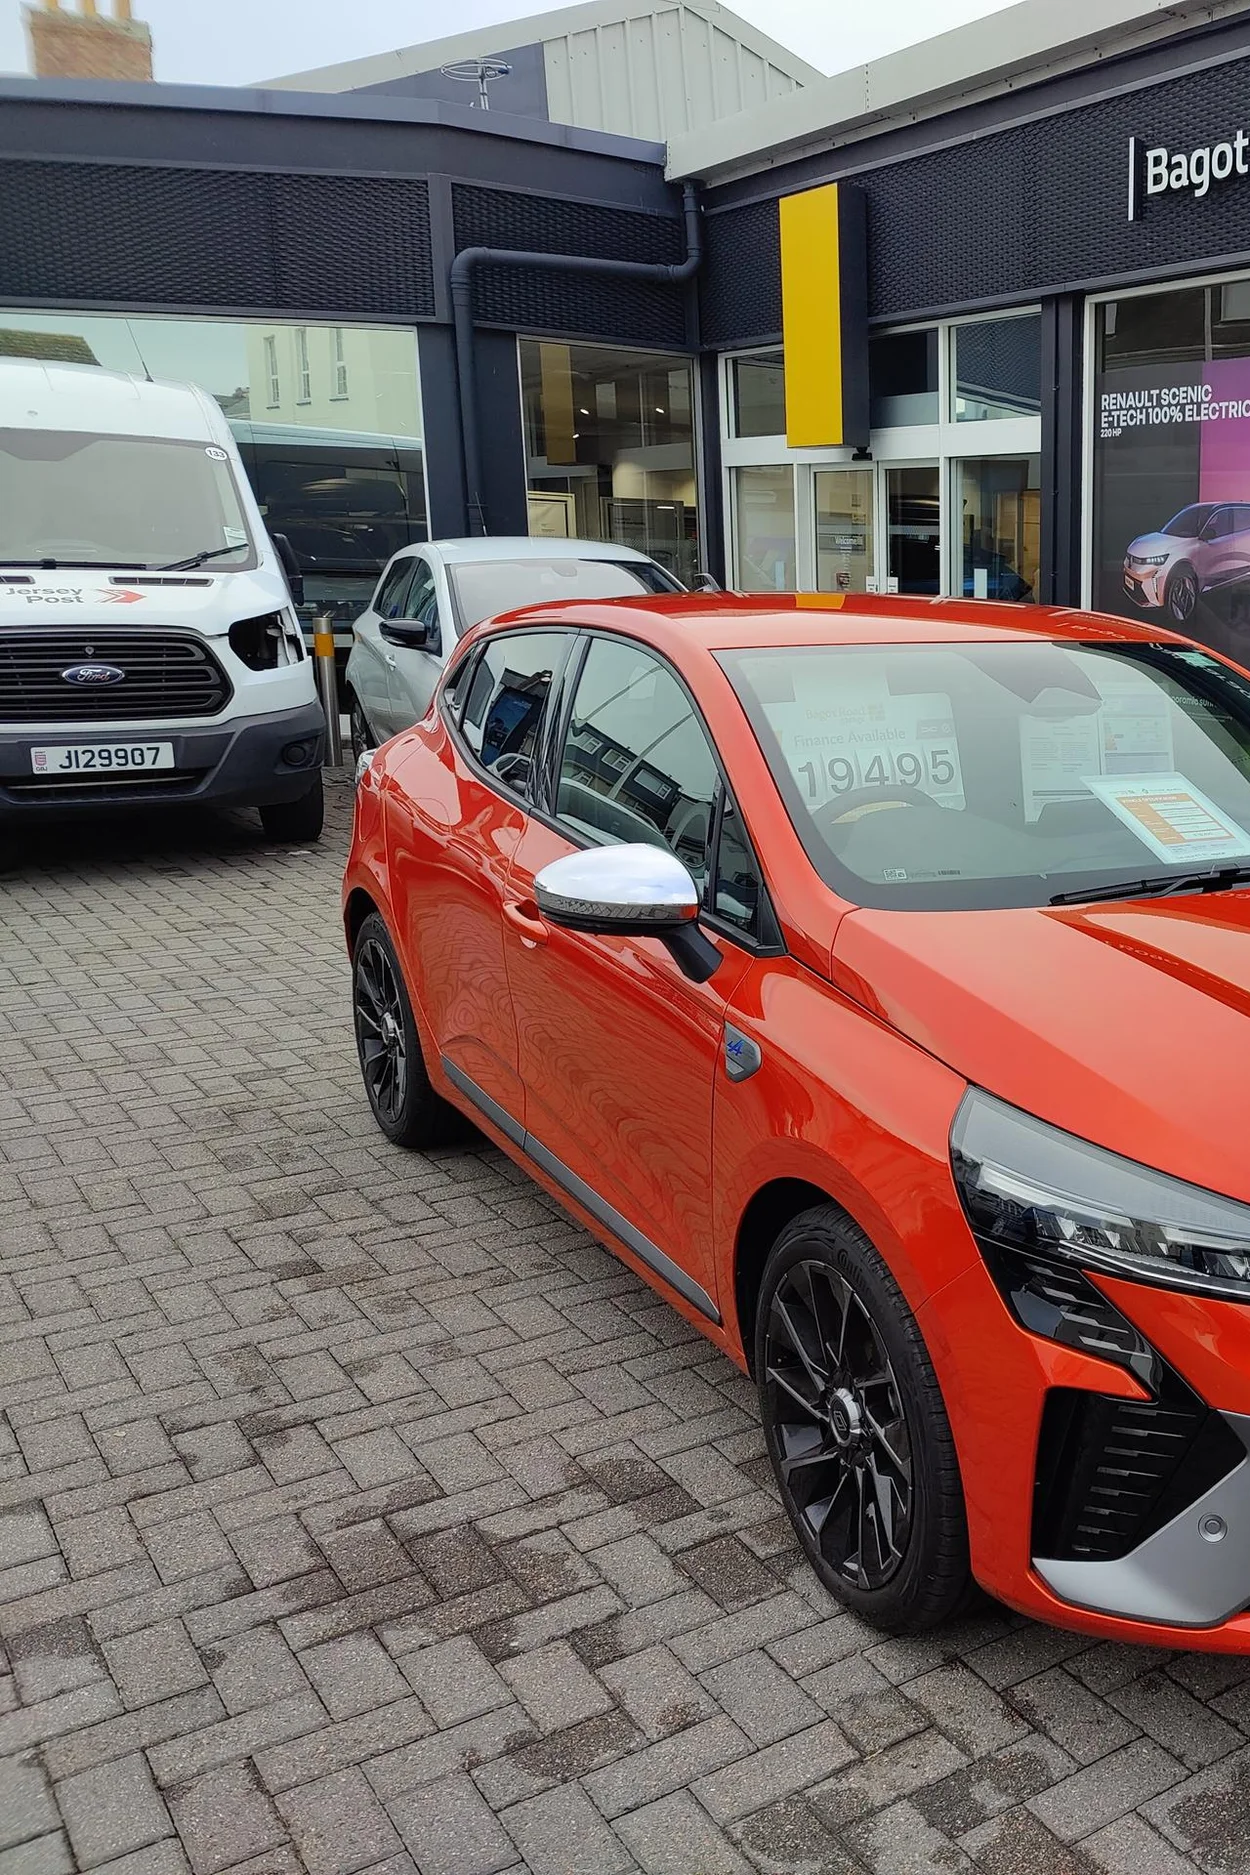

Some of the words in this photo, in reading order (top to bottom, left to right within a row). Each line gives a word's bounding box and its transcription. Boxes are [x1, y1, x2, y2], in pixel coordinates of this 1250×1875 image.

[1146, 129, 1249, 197] Bagot
[1101, 389, 1160, 411] RENAULT
[1161, 384, 1213, 406] SCENIC
[1101, 407, 1147, 428] E-TECH
[1148, 405, 1183, 425] 100%
[1100, 429, 1112, 438] 220
[1112, 428, 1122, 437] HP
[5, 587, 83, 597] Jersey
[26, 596, 85, 604] Post
[77, 668, 110, 681] Ford
[794, 735, 844, 748] Finance
[848, 728, 906, 744] Available
[59, 747, 160, 769] J129907
[798, 749, 955, 798] 19495
